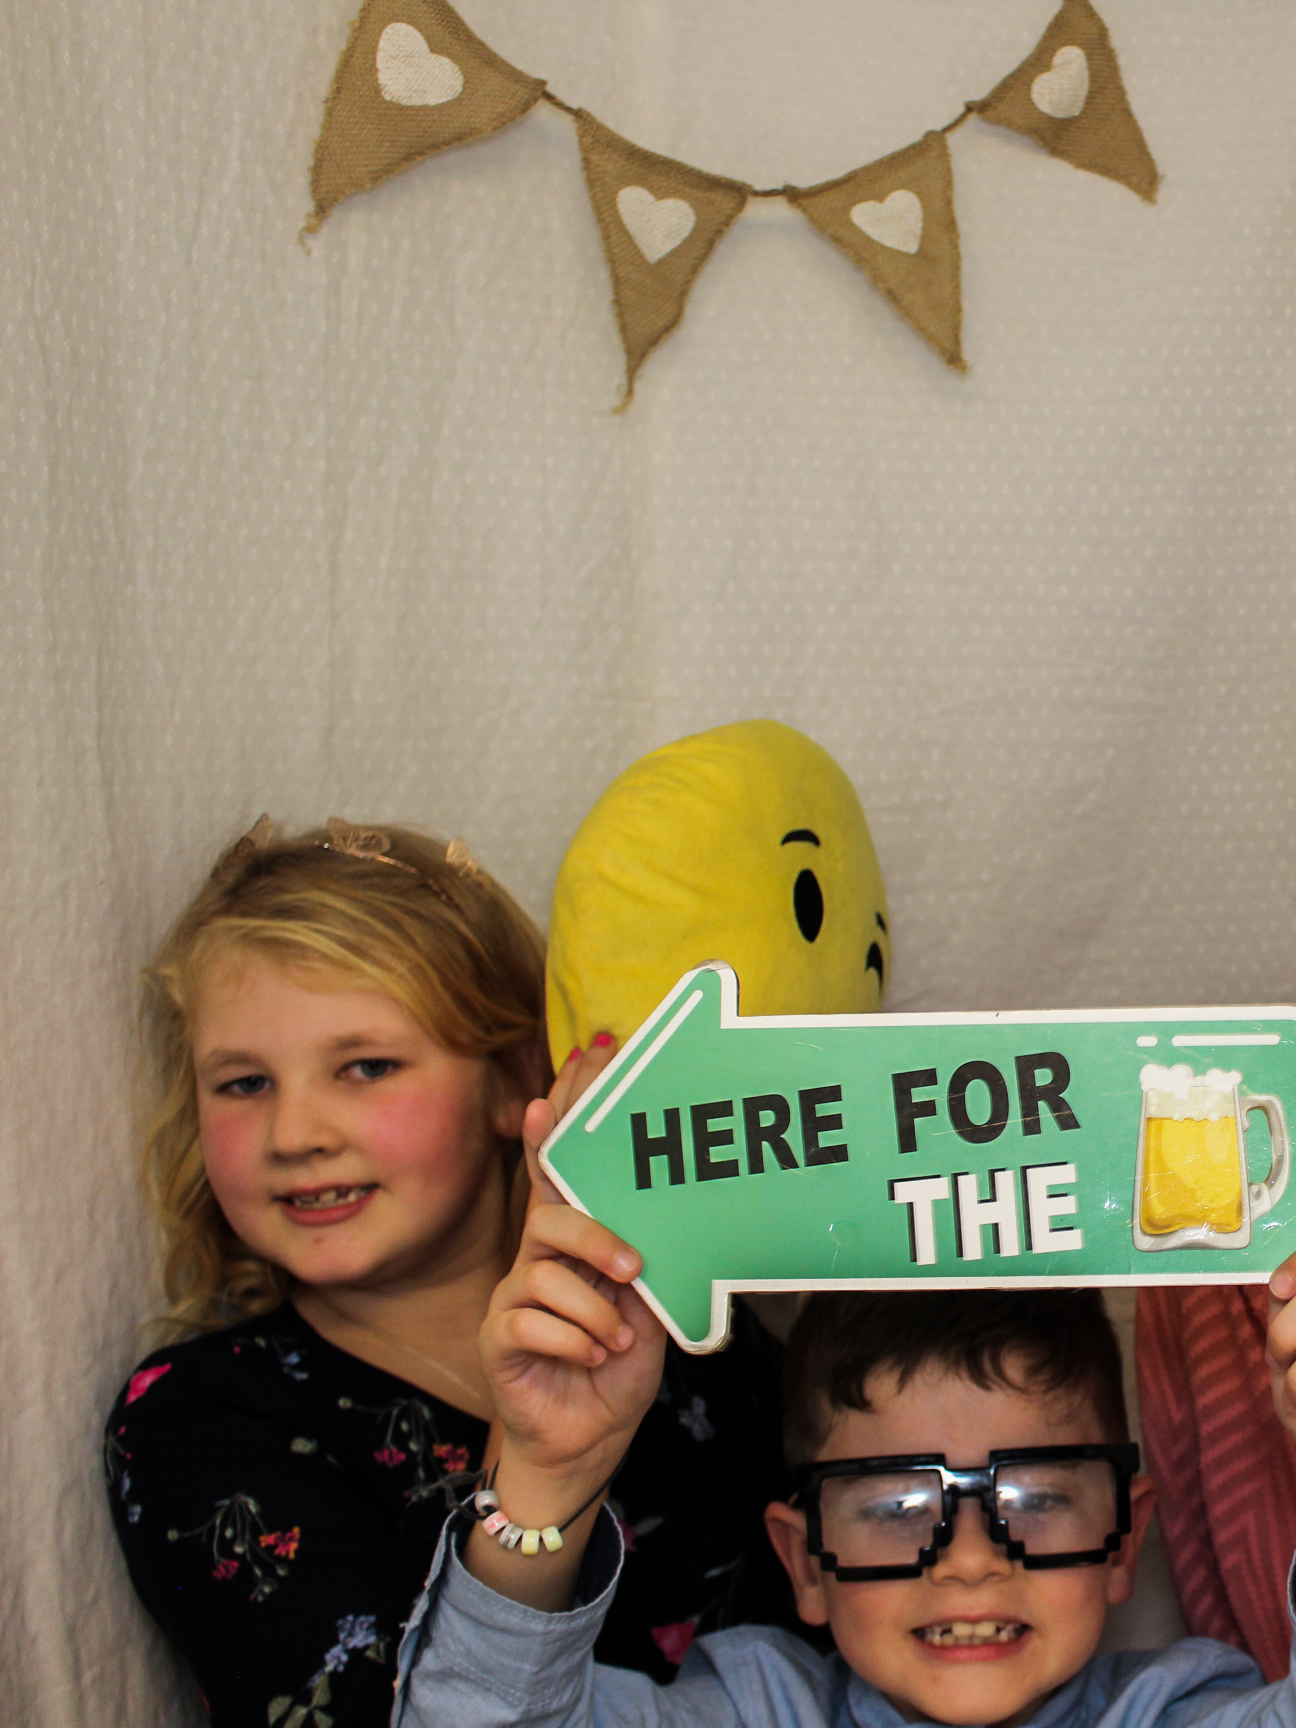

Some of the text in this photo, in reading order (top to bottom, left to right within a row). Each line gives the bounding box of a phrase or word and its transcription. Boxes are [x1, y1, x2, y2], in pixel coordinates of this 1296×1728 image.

[630, 1051, 1082, 1191] HERE FOR
[889, 1162, 1084, 1266] THE
